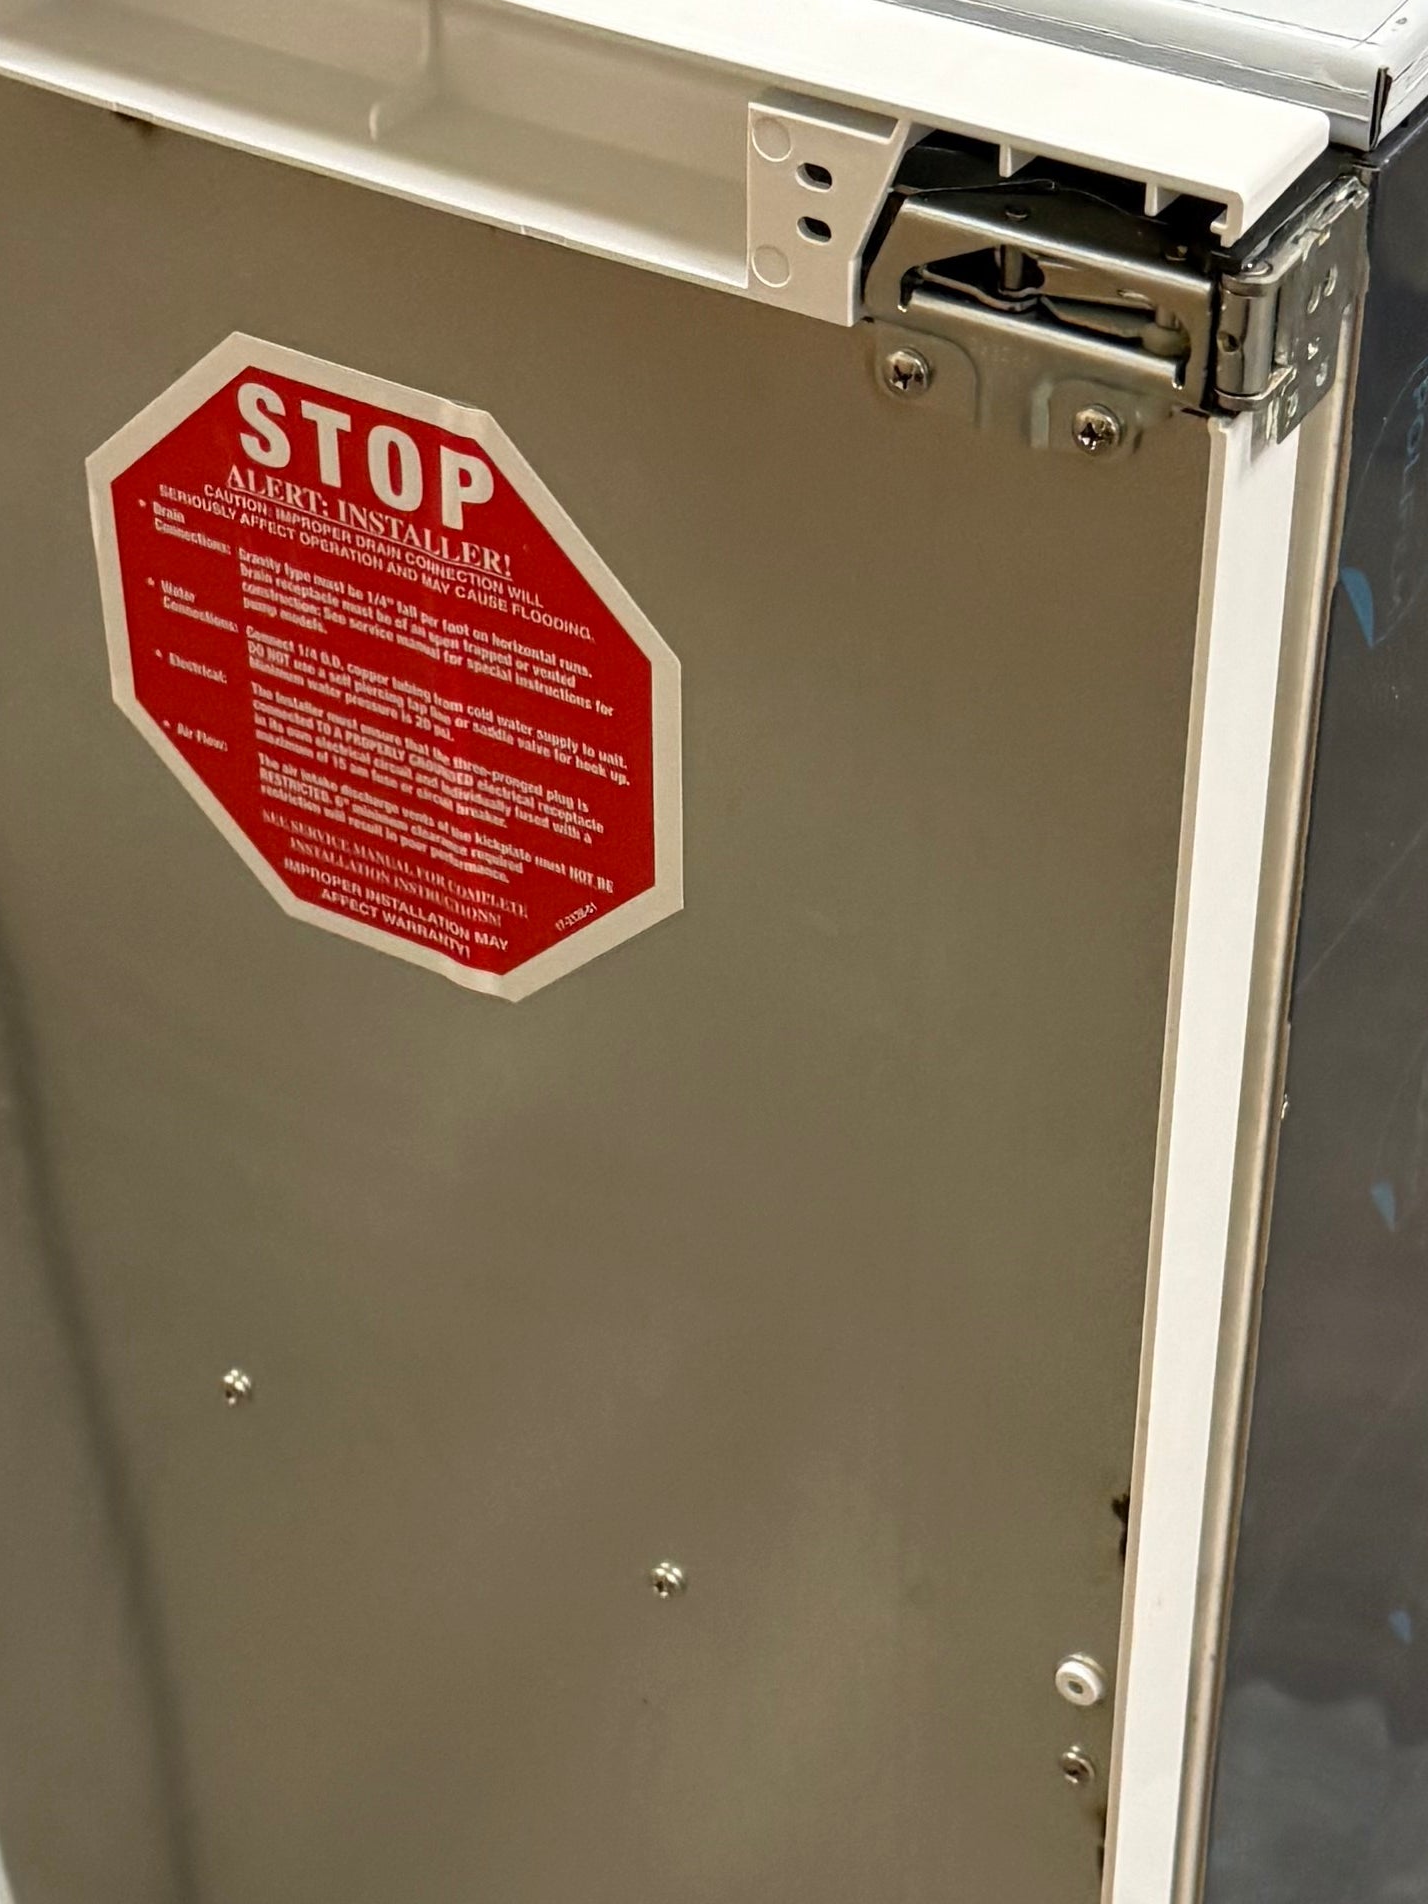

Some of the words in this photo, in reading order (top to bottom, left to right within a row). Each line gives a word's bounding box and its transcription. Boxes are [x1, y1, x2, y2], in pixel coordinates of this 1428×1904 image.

[237, 382, 494, 530] STOP
[159, 484, 236, 520] SERIOUSLY
[239, 512, 295, 540] AFFECT
[299, 531, 383, 571] OPERATION
[386, 561, 418, 582] AND
[421, 572, 450, 595] MAY
[454, 585, 508, 613] CAUSE
[227, 464, 329, 518] ALERT:
[338, 499, 511, 577] INSTALLER!
[275, 507, 352, 544] IMPROPER
[355, 534, 401, 561] DRAIN
[404, 551, 504, 595] CONNECTION
[507, 585, 544, 609] WILL
